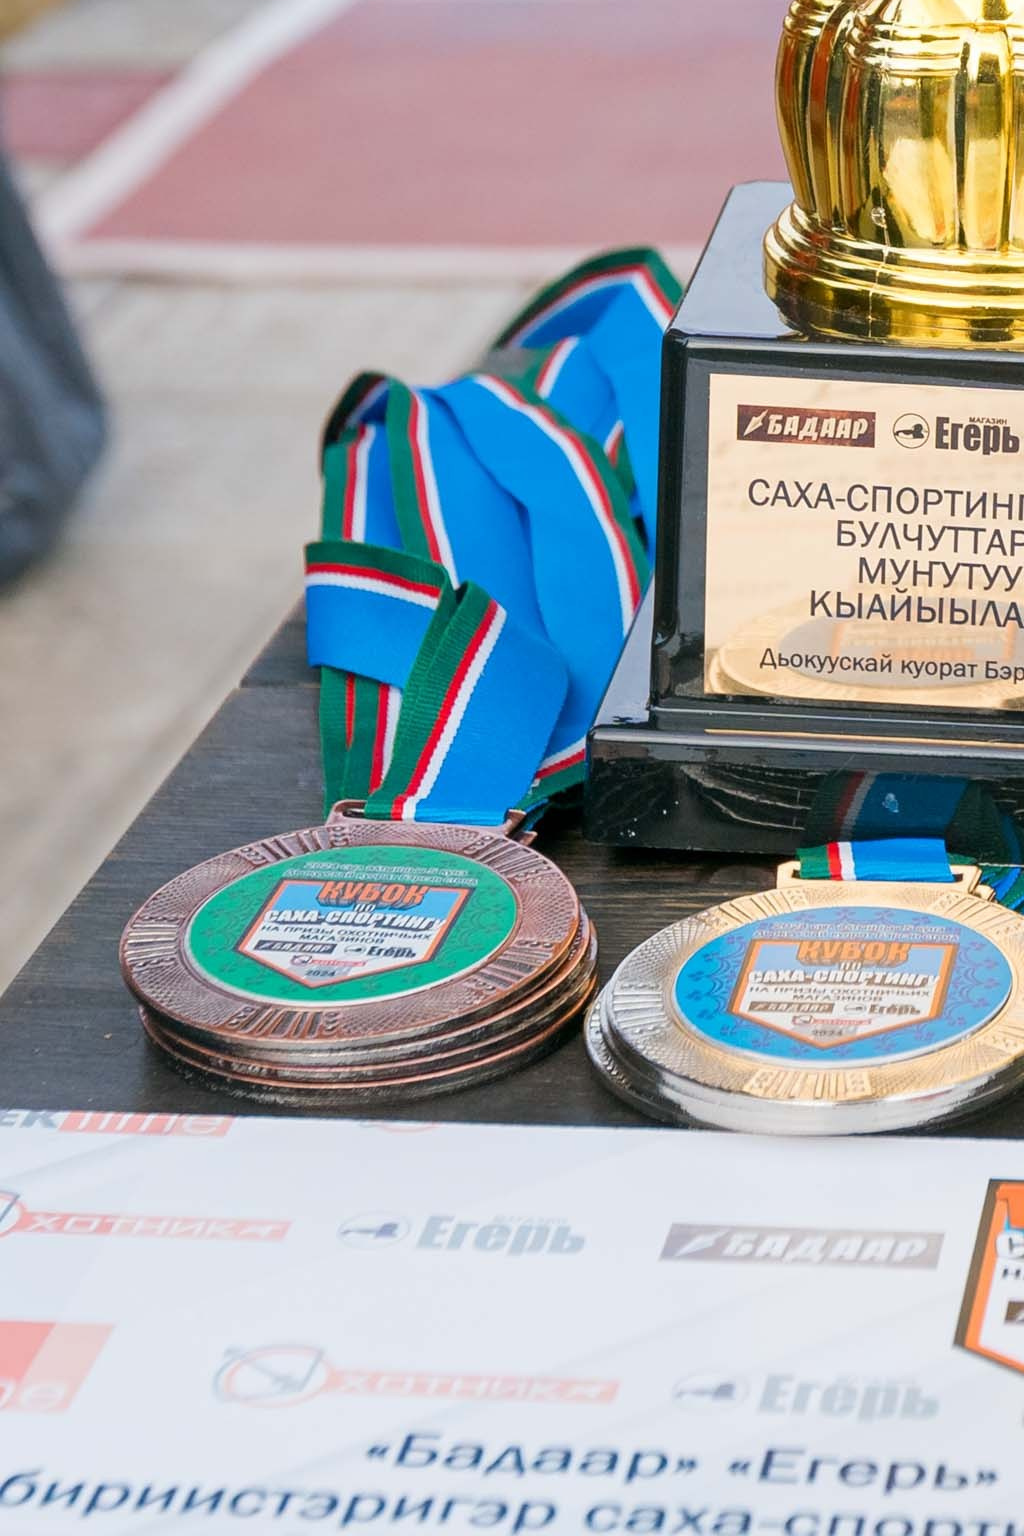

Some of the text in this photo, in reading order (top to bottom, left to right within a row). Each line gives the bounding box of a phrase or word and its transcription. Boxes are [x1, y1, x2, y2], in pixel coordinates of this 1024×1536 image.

[766, 413, 869, 441] БАДААР
[968, 416, 1008, 425] МАГАЗИН
[935, 416, 1021, 456] Егерь
[759, 647, 893, 674] Дьокуускай
[900, 659, 978, 681] куорат
[316, 881, 430, 907] КУБОК
[263, 909, 447, 931] САХА-СПОРТИНГУ
[796, 941, 911, 963] КУБОК
[748, 969, 941, 987] САХА-СПОРТИНГУ
[414, 1213, 586, 1257] Егерь
[720, 1232, 929, 1265] БАДААР
[757, 1372, 940, 1424] Егерь
[367, 1432, 698, 1480] «Бадаар»
[726, 1447, 1000, 1495] «Егерь»
